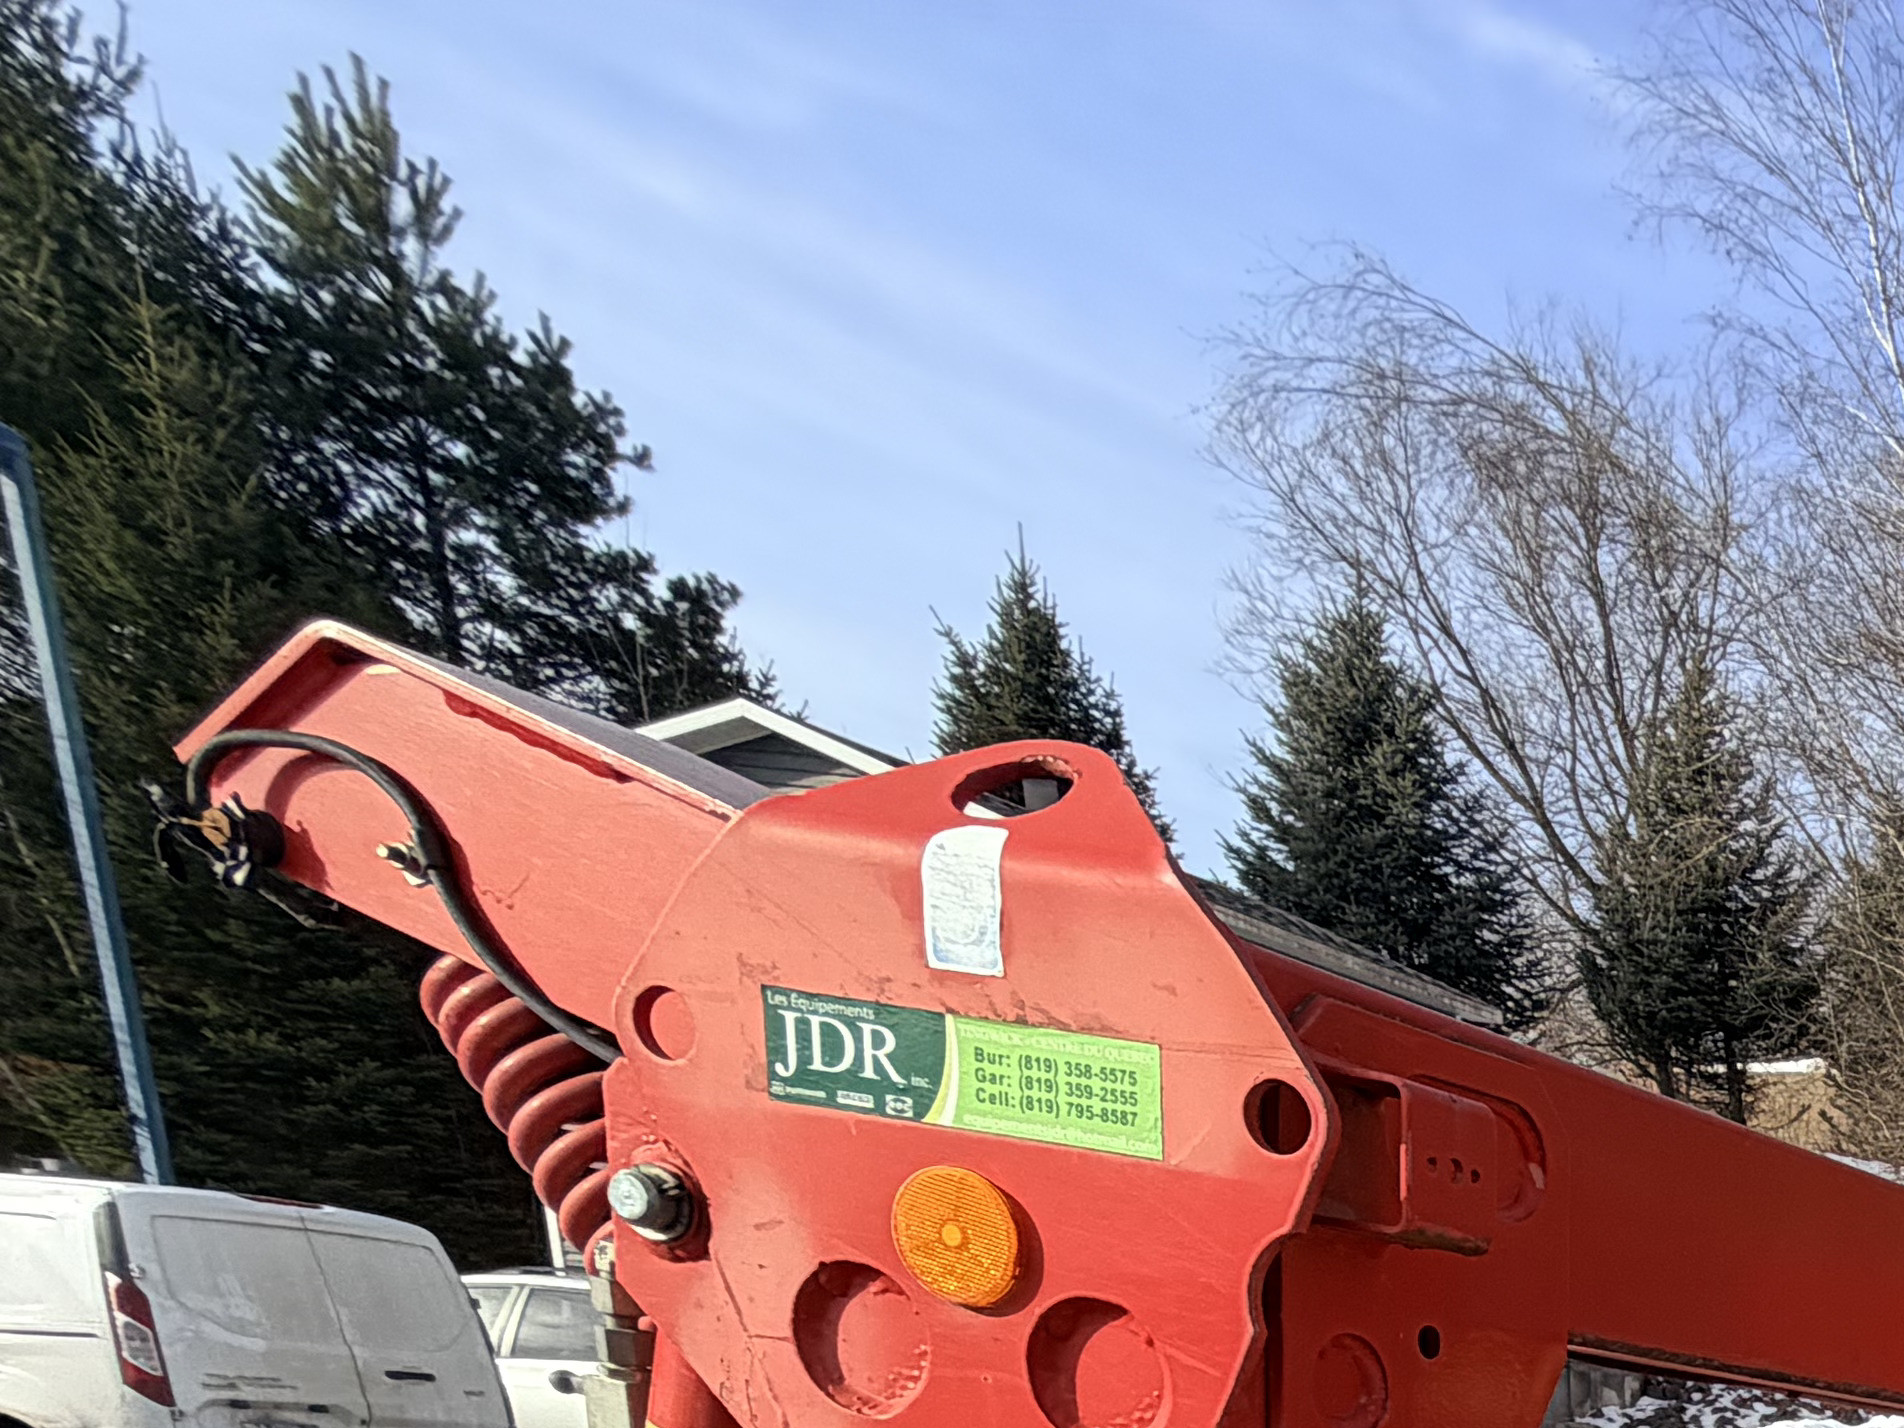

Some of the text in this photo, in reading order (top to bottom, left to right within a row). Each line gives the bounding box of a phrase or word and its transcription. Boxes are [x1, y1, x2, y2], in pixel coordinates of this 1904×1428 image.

[774, 1009, 908, 1086] JDR
[973, 1046, 1138, 1087] Bur: (819) 358-5575
[974, 1067, 1139, 1107] Gar: (819) 359-2555
[975, 1087, 1138, 1128] Cell: (819) 795-8587
